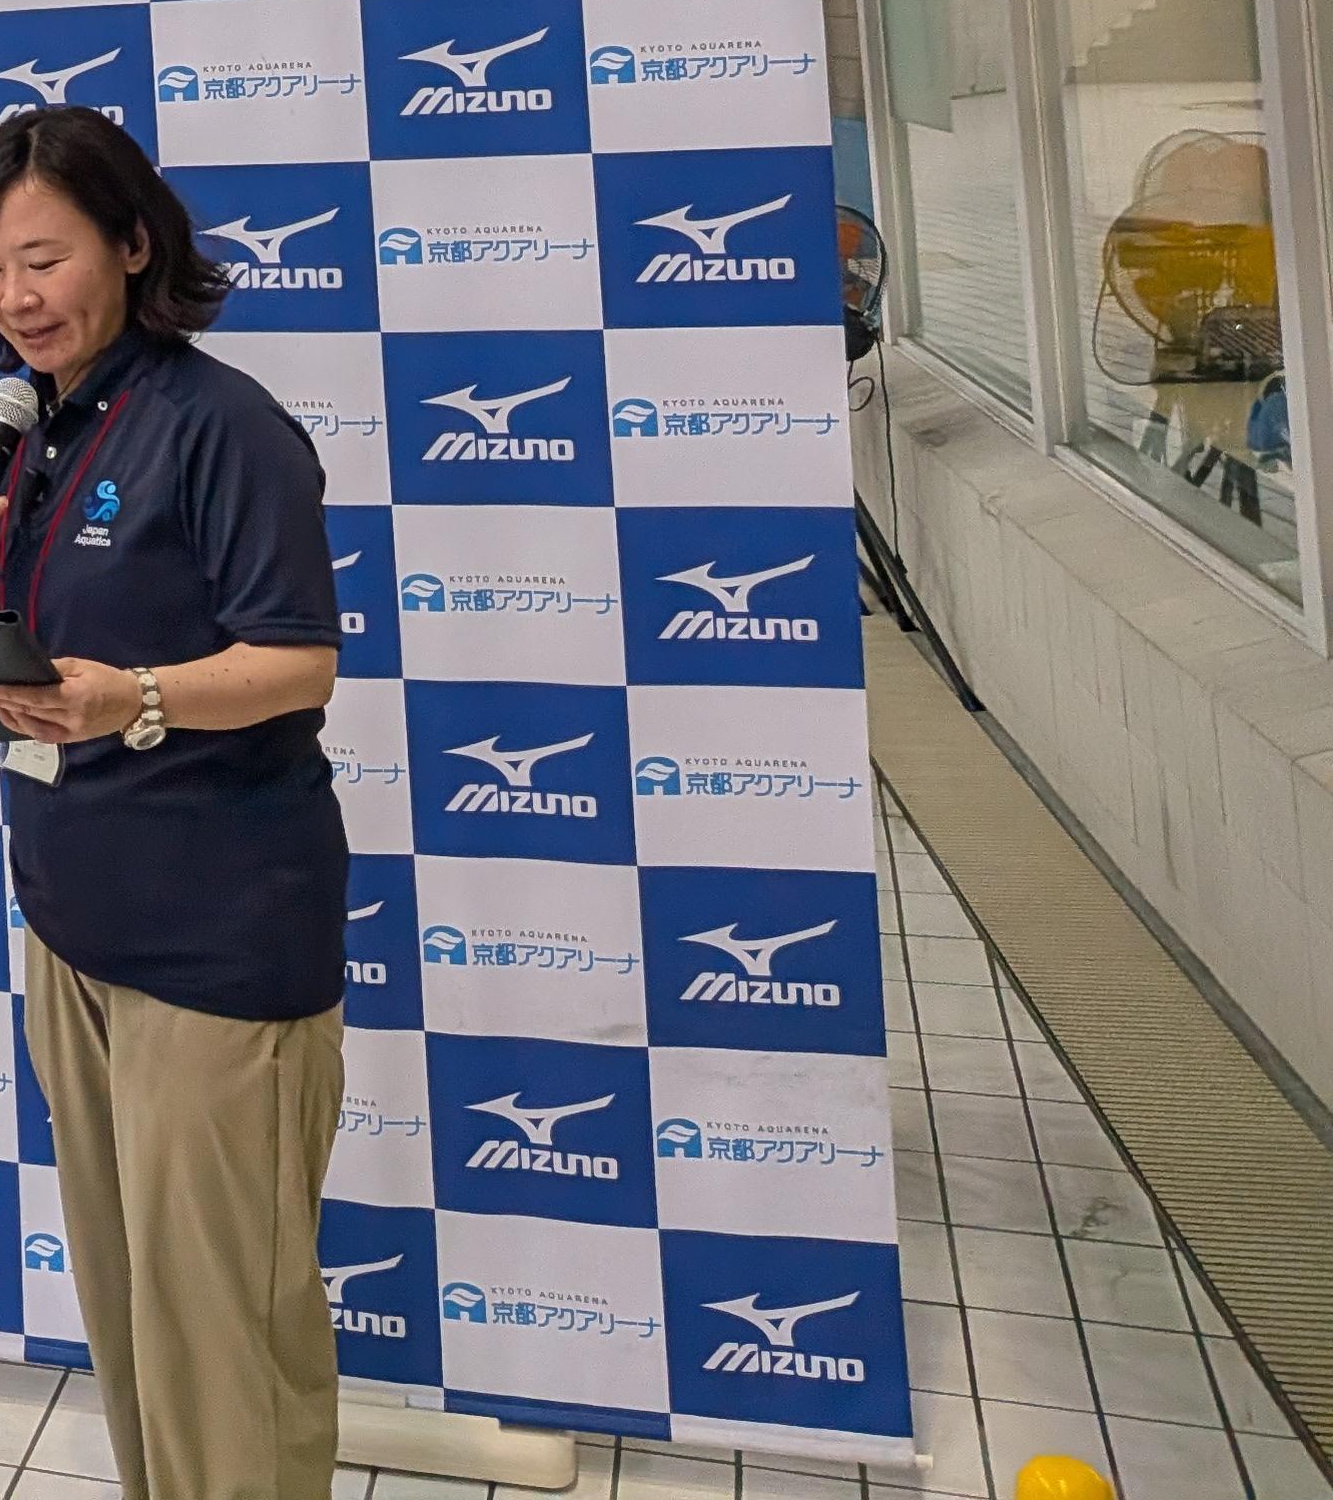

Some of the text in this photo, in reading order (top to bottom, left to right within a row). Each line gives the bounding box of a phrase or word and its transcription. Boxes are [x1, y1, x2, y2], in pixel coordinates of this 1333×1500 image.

[640, 40, 762, 54] KYOTO AQUARENA
[203, 61, 312, 73] KYOTO AQUARENA
[641, 53, 816, 80] 京都アクアリーナ
[203, 75, 361, 99] 京都アクアリーナ
[400, 87, 551, 115] MIZUNO
[426, 224, 543, 236] KYOTO AQUARENA
[428, 239, 594, 263] 京都アクアリーナ
[637, 254, 795, 282] MIZUNO
[662, 397, 784, 408] KYOTO AQUARENA
[664, 412, 839, 436] 京都アクアリーナ
[422, 433, 574, 460] MIZUNO
[74, 534, 111, 547] Aquatics
[82, 524, 109, 537] Japan
[449, 574, 566, 585] KYOTO AQUARENA
[451, 589, 617, 614] 京都アクアリーナ
[659, 611, 818, 640] MIZUNO
[684, 757, 808, 768] KYOTO AQUARENA
[687, 772, 861, 797] 京都アクアリーナ
[445, 785, 596, 817] MIZUNO
[471, 928, 588, 943] KYOTO AQUARENA
[472, 943, 639, 973] 京都アクアリーナ
[680, 973, 839, 1005] MIZUNO
[706, 1121, 829, 1136] KYOTO AQUARENA
[465, 1141, 618, 1180] MIZUNO
[708, 1137, 883, 1166] 京都アクアリーナ
[489, 1286, 609, 1306] KYOTO AQUARENA
[492, 1302, 661, 1337] 京都アクアリーナ
[703, 1343, 864, 1381] MIZUNO
